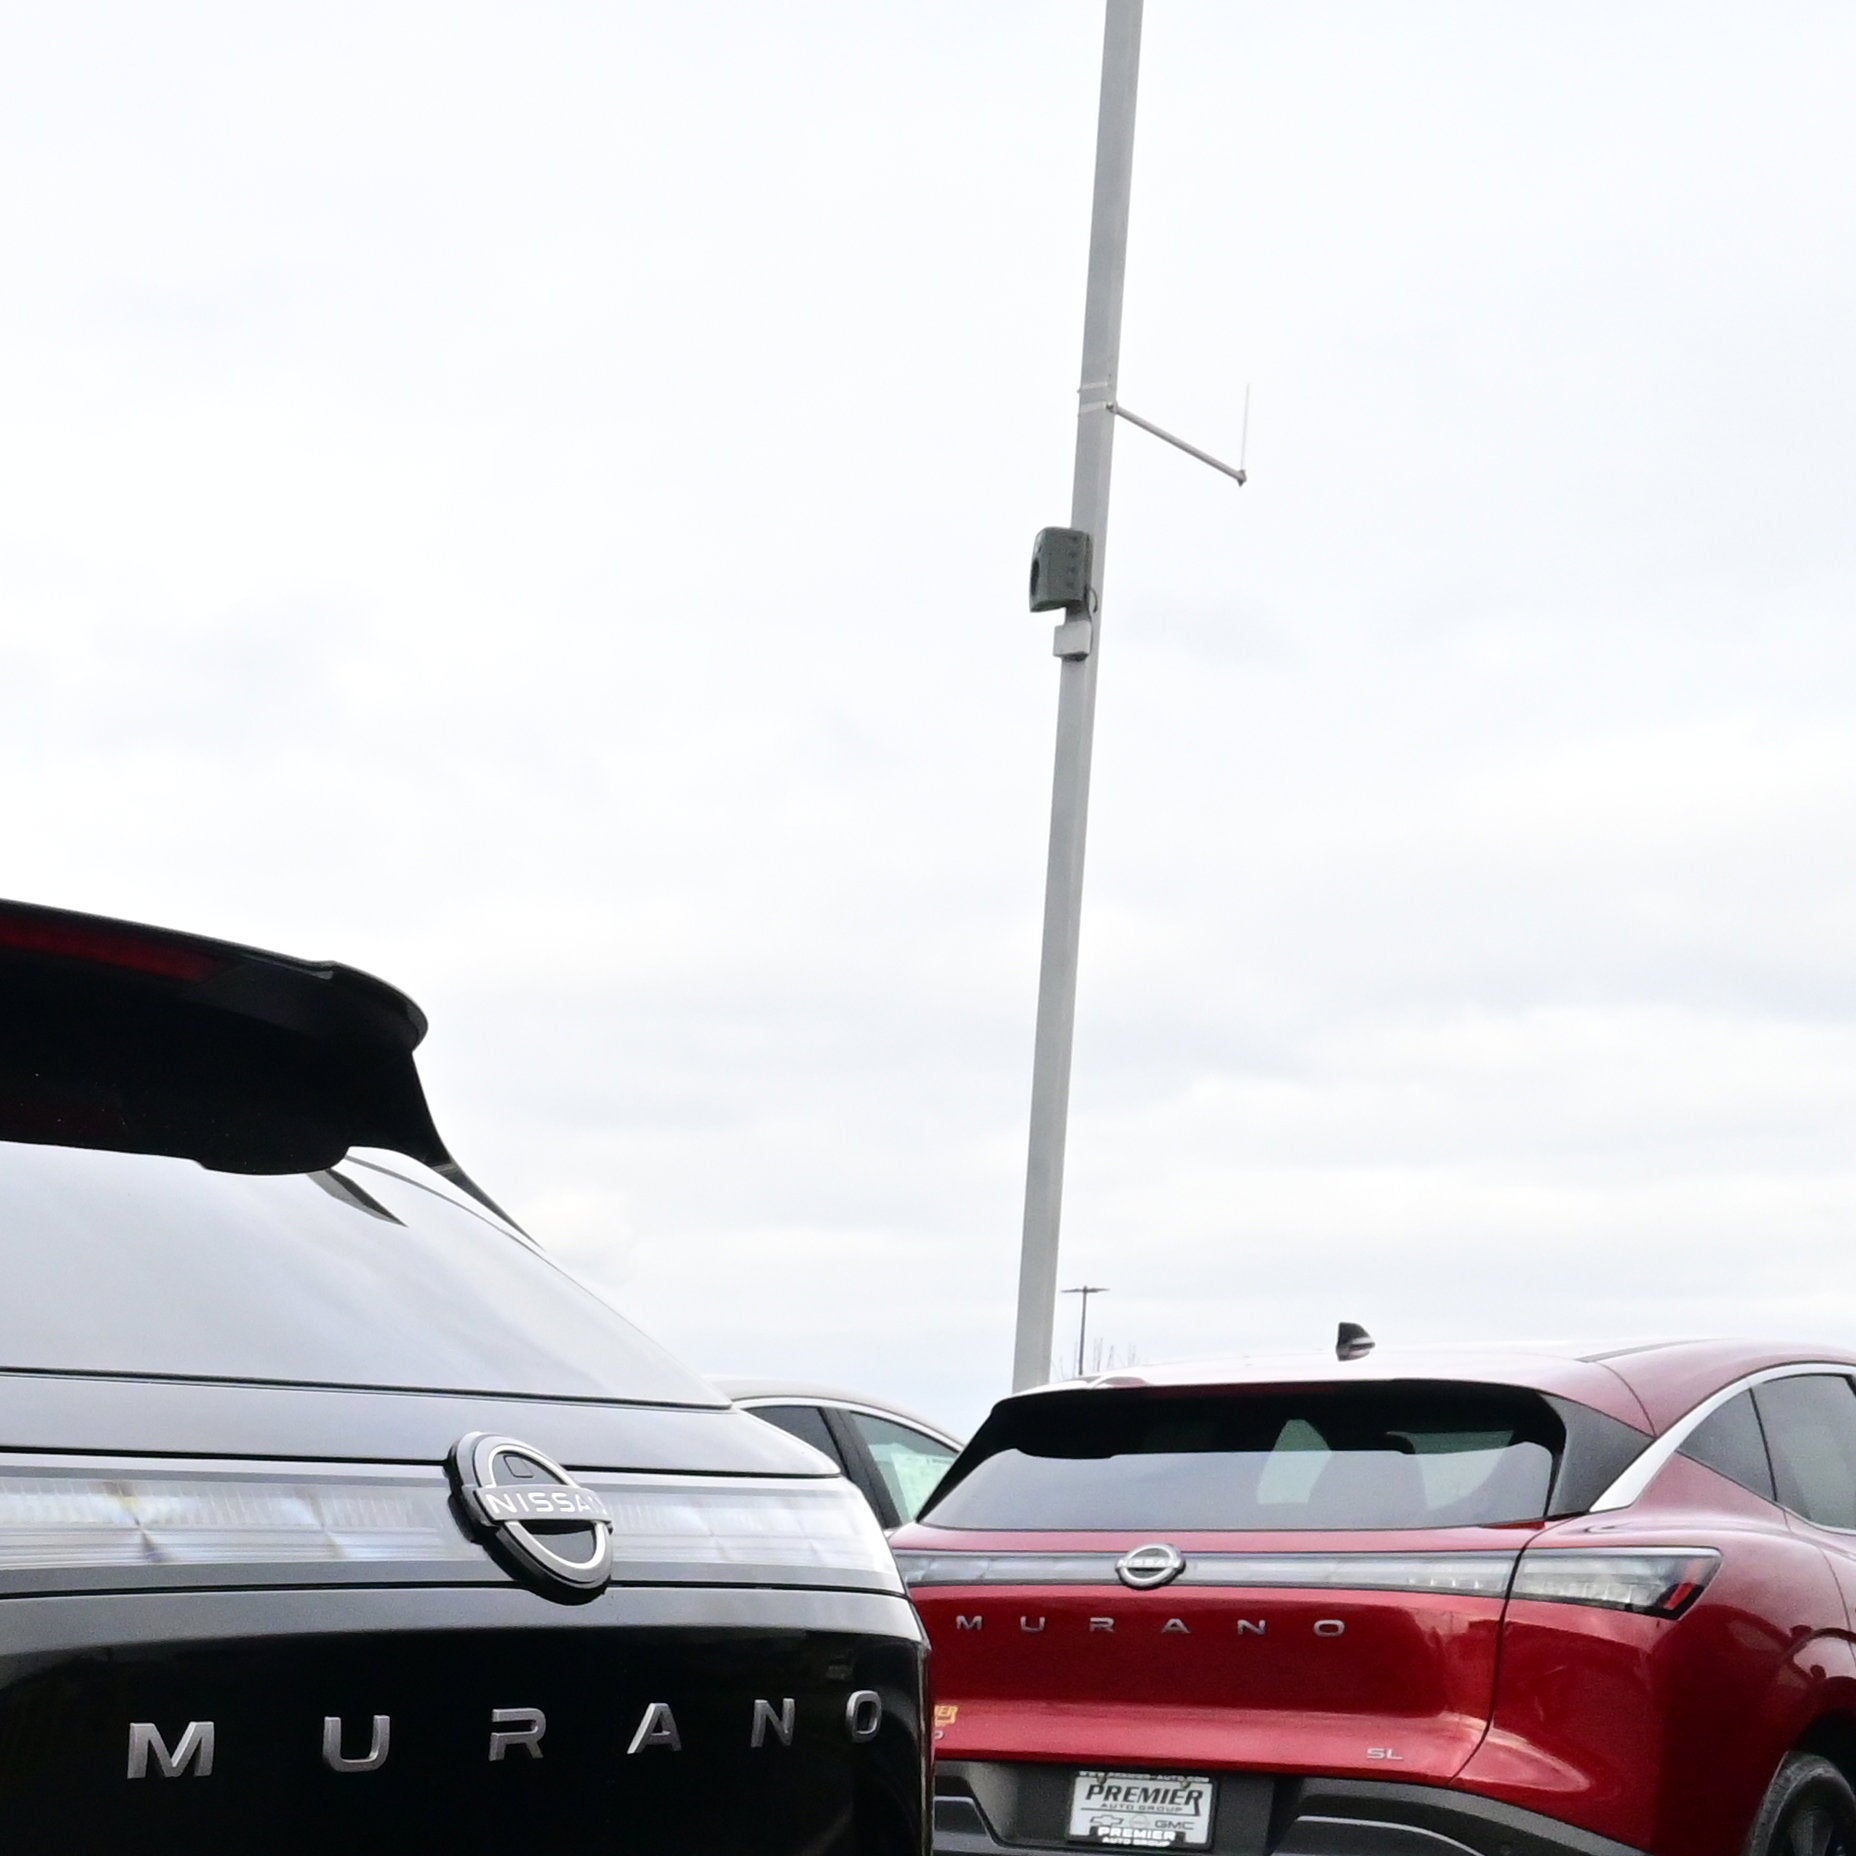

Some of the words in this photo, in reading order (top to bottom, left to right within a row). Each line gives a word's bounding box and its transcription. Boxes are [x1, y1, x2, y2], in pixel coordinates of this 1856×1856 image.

[485, 1491, 607, 1515] NISSAN
[955, 1615, 1346, 1637] MURANO
[126, 1689, 883, 1780] MURANO
[1367, 1748, 1403, 1760] SL
[1086, 1784, 1203, 1812] PREMIER
[1097, 1826, 1176, 1841] PREMIER
[1154, 1819, 1195, 1830] GMC
